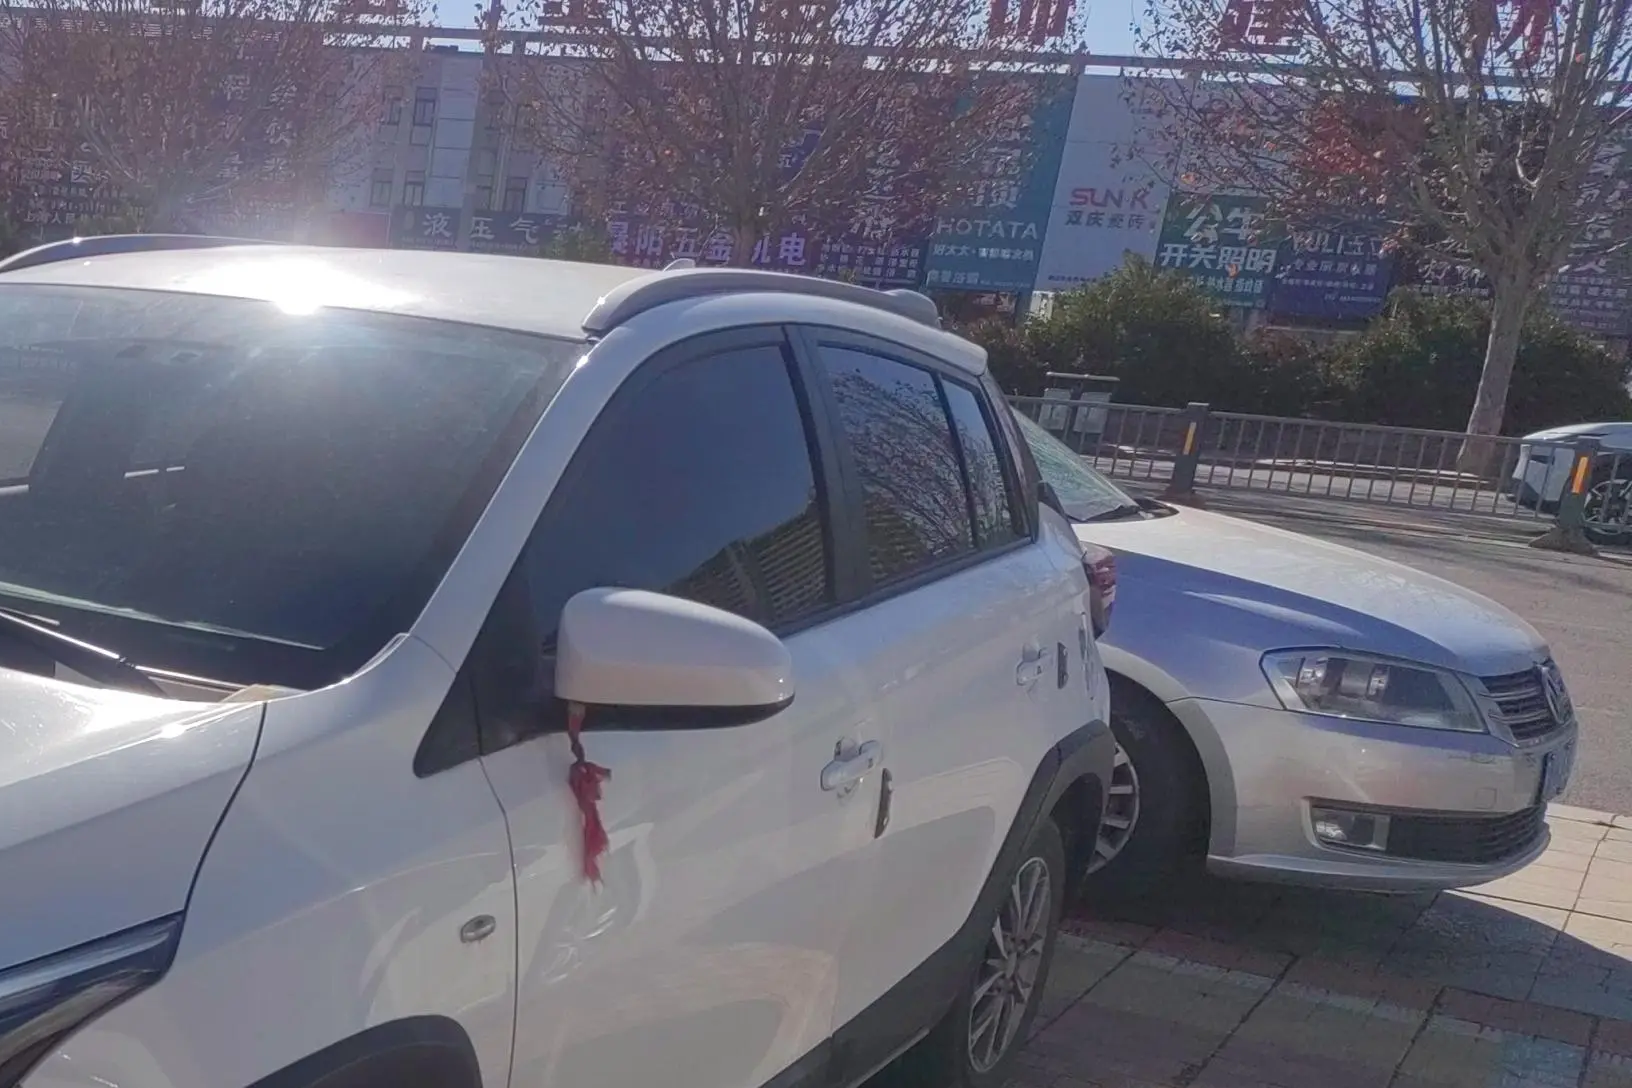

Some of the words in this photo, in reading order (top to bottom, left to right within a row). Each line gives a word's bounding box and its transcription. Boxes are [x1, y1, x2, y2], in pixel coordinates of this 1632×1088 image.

[935, 219, 1038, 240] HOTATA
[1183, 202, 1265, 243] 公牛
[1160, 243, 1277, 274] 开关照明
